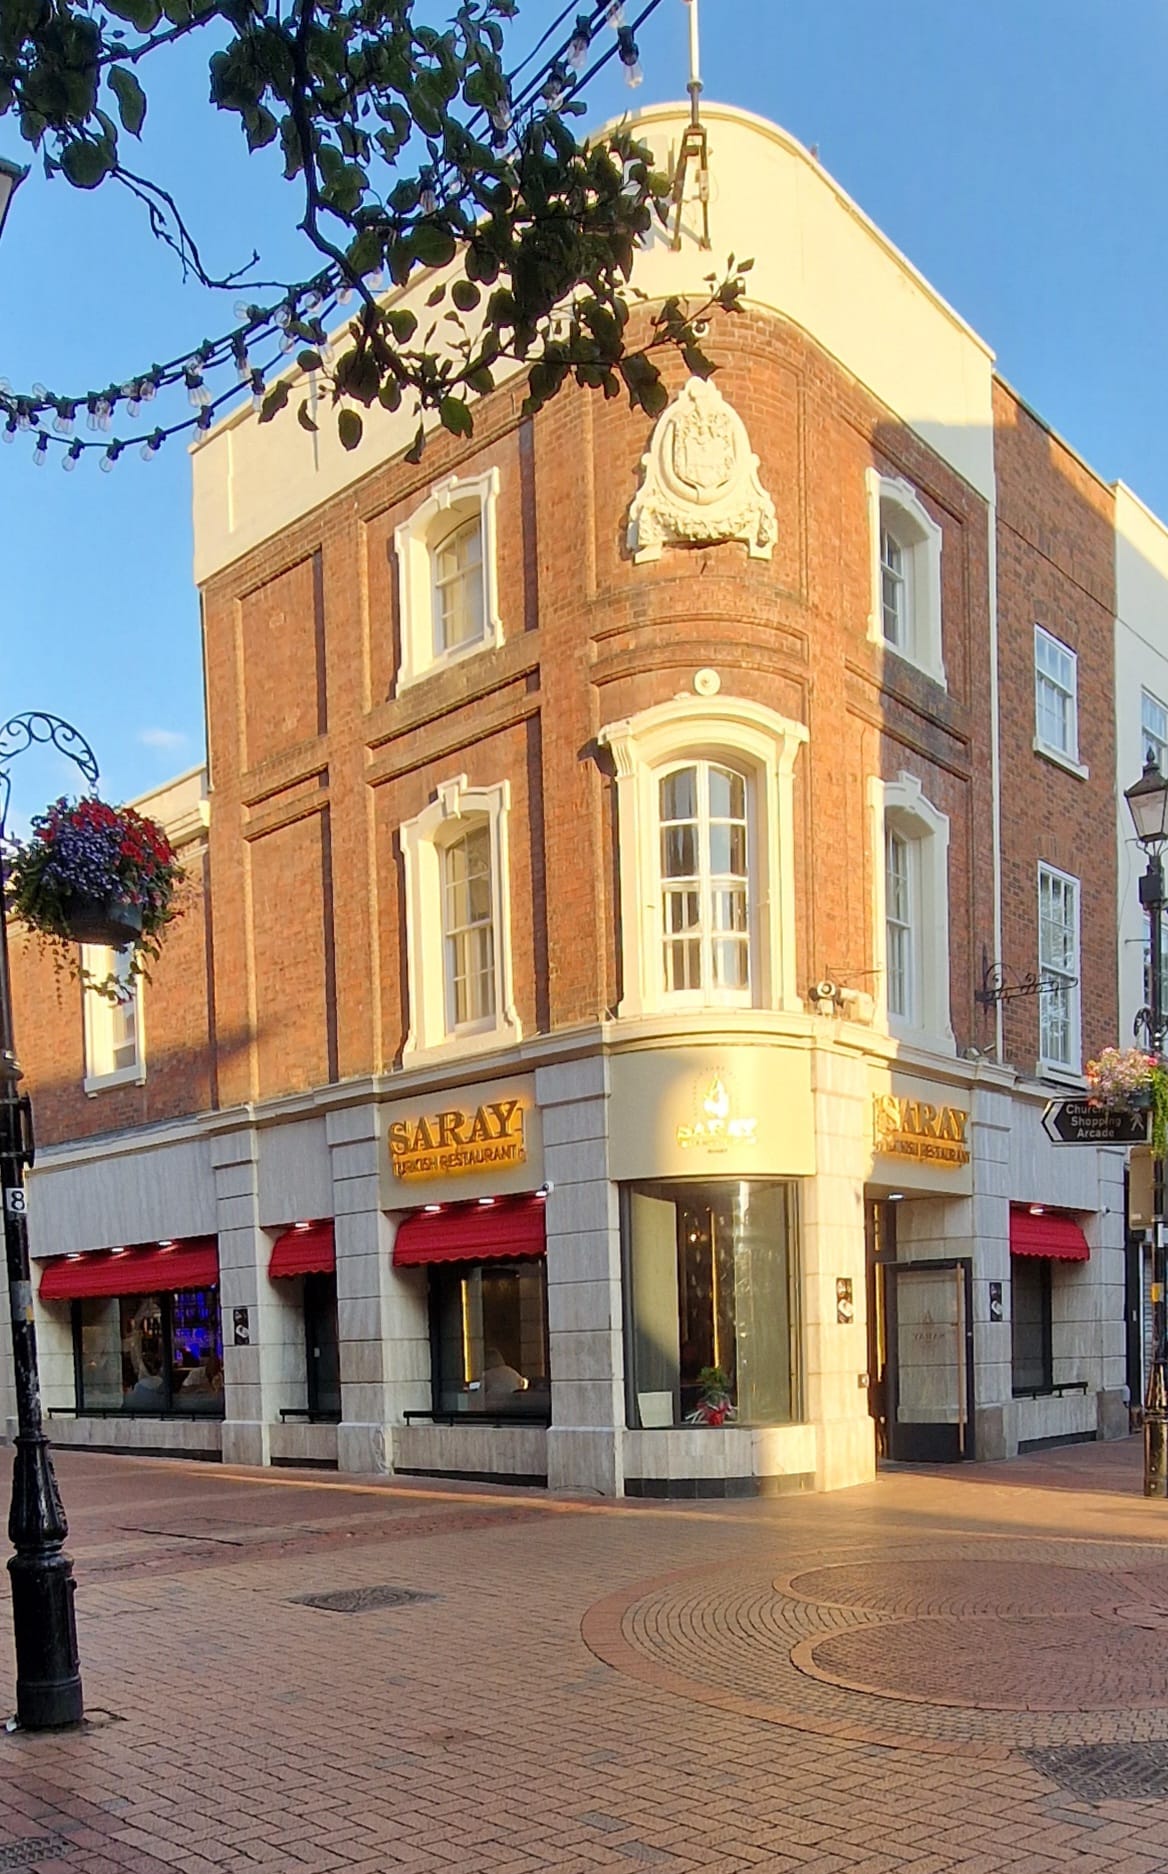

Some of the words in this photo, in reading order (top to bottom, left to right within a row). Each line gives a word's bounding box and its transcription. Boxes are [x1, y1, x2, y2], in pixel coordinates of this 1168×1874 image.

[386, 1097, 519, 1156] SARAY
[877, 1094, 968, 1144] SARAY
[1071, 1115, 1122, 1128] Shopping
[1077, 1127, 1115, 1138] Arcade
[11, 1190, 26, 1211] 8
